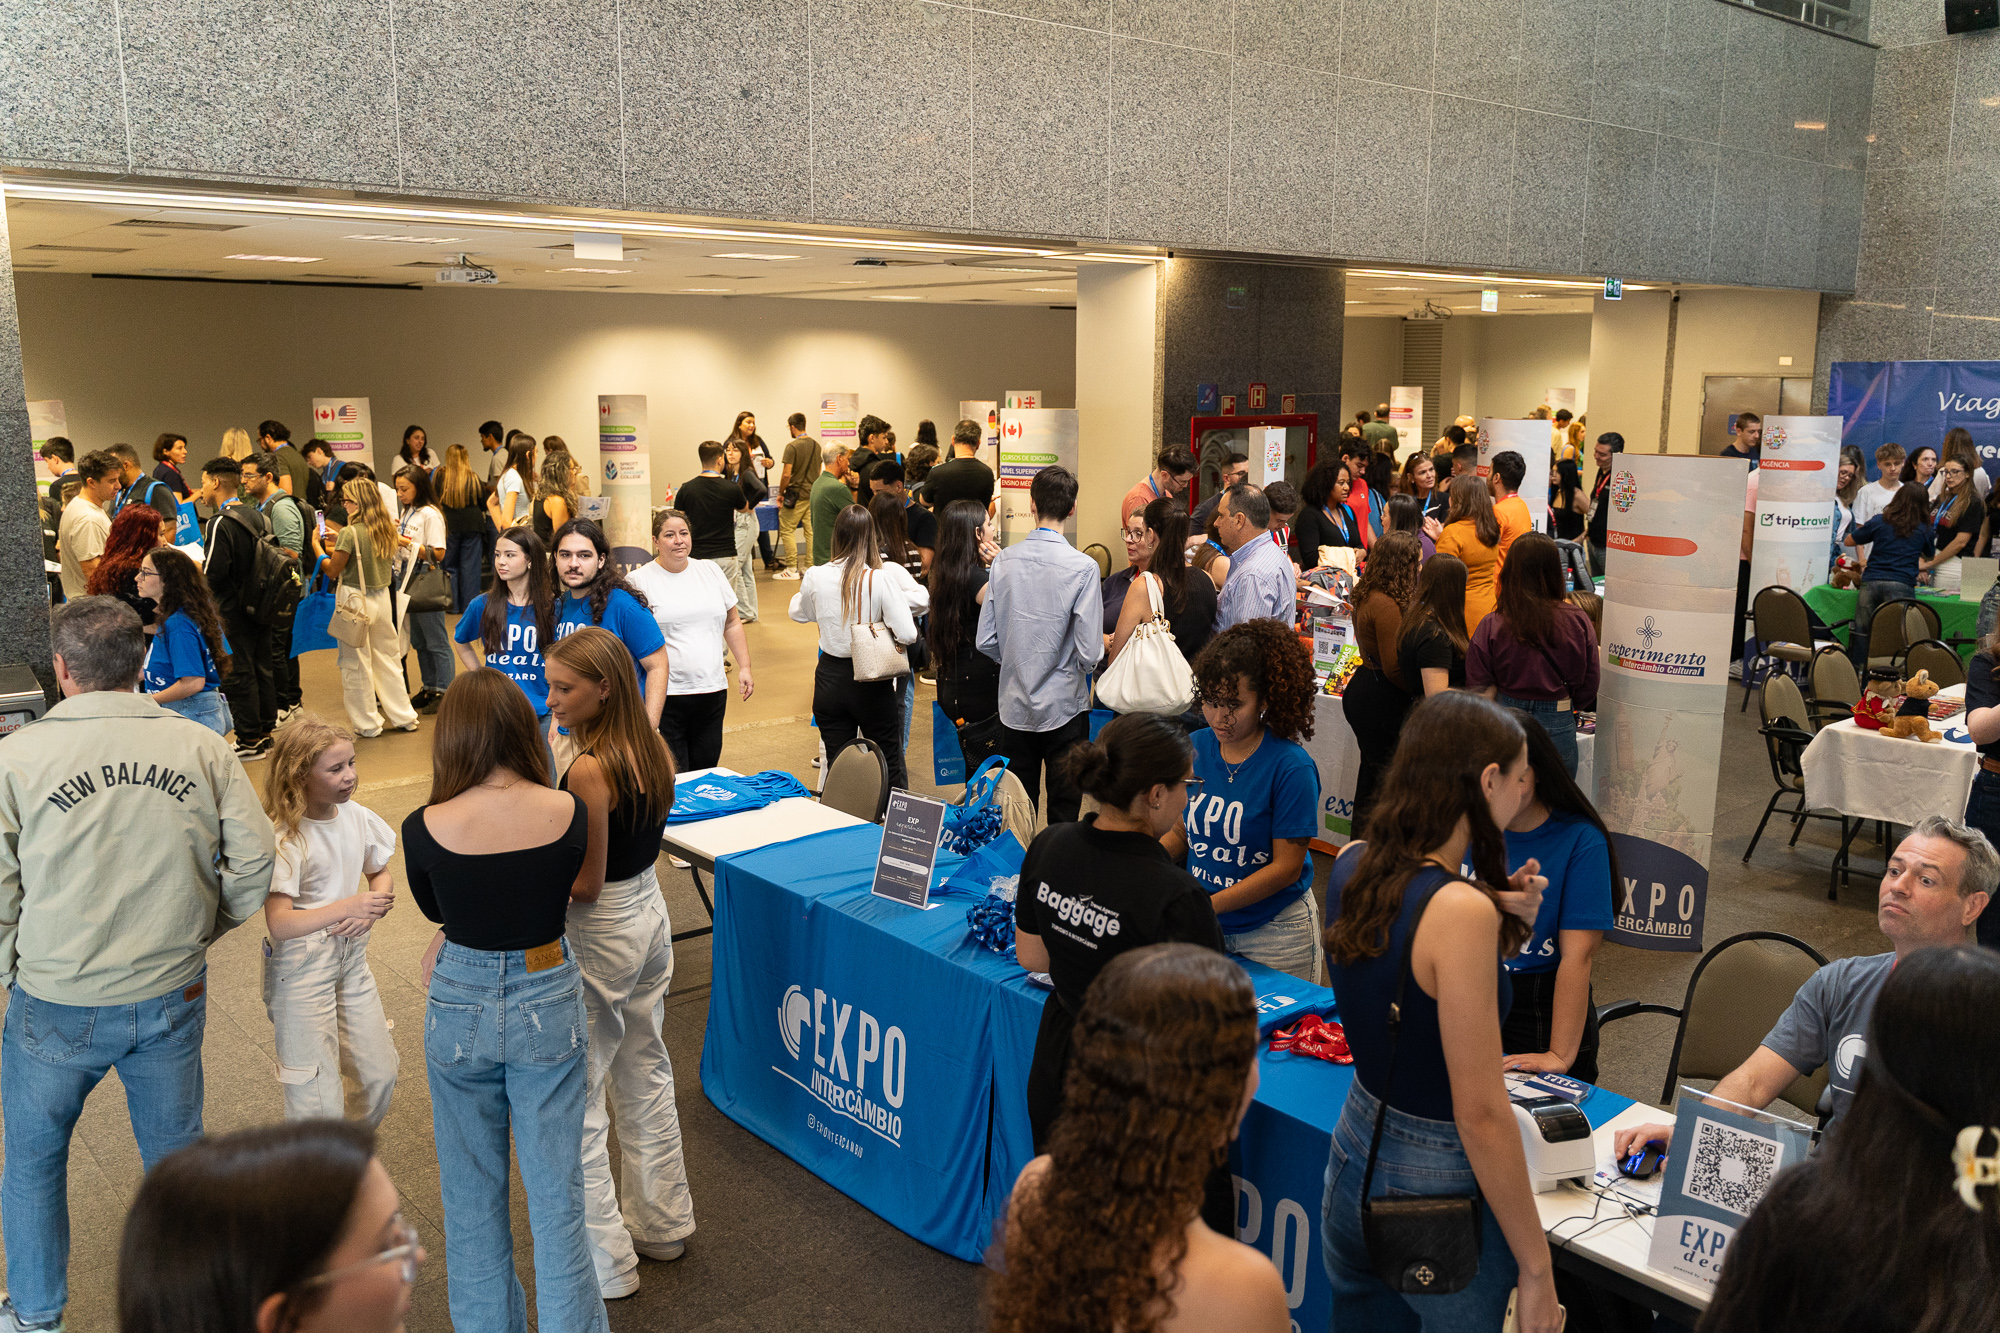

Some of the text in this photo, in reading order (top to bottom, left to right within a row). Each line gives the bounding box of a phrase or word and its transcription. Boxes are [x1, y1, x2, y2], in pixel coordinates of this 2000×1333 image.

[1607, 533, 1636, 547] AGÊNCIA
[1776, 515, 1831, 529] triptravel
[1334, 646, 1352, 675] IDIOMAS
[1608, 642, 1706, 666] experimento
[1622, 658, 1702, 676] Intercâmbio Cultural
[48, 762, 197, 814] NEW BALANCE
[1187, 792, 1244, 845] XPO
[1036, 881, 1121, 938] Baggage
[1621, 876, 1695, 921] XPO
[813, 987, 907, 1110] EXPO
[811, 1068, 902, 1140] INTERCÂMBIO
[1679, 1220, 1726, 1258] EXP
